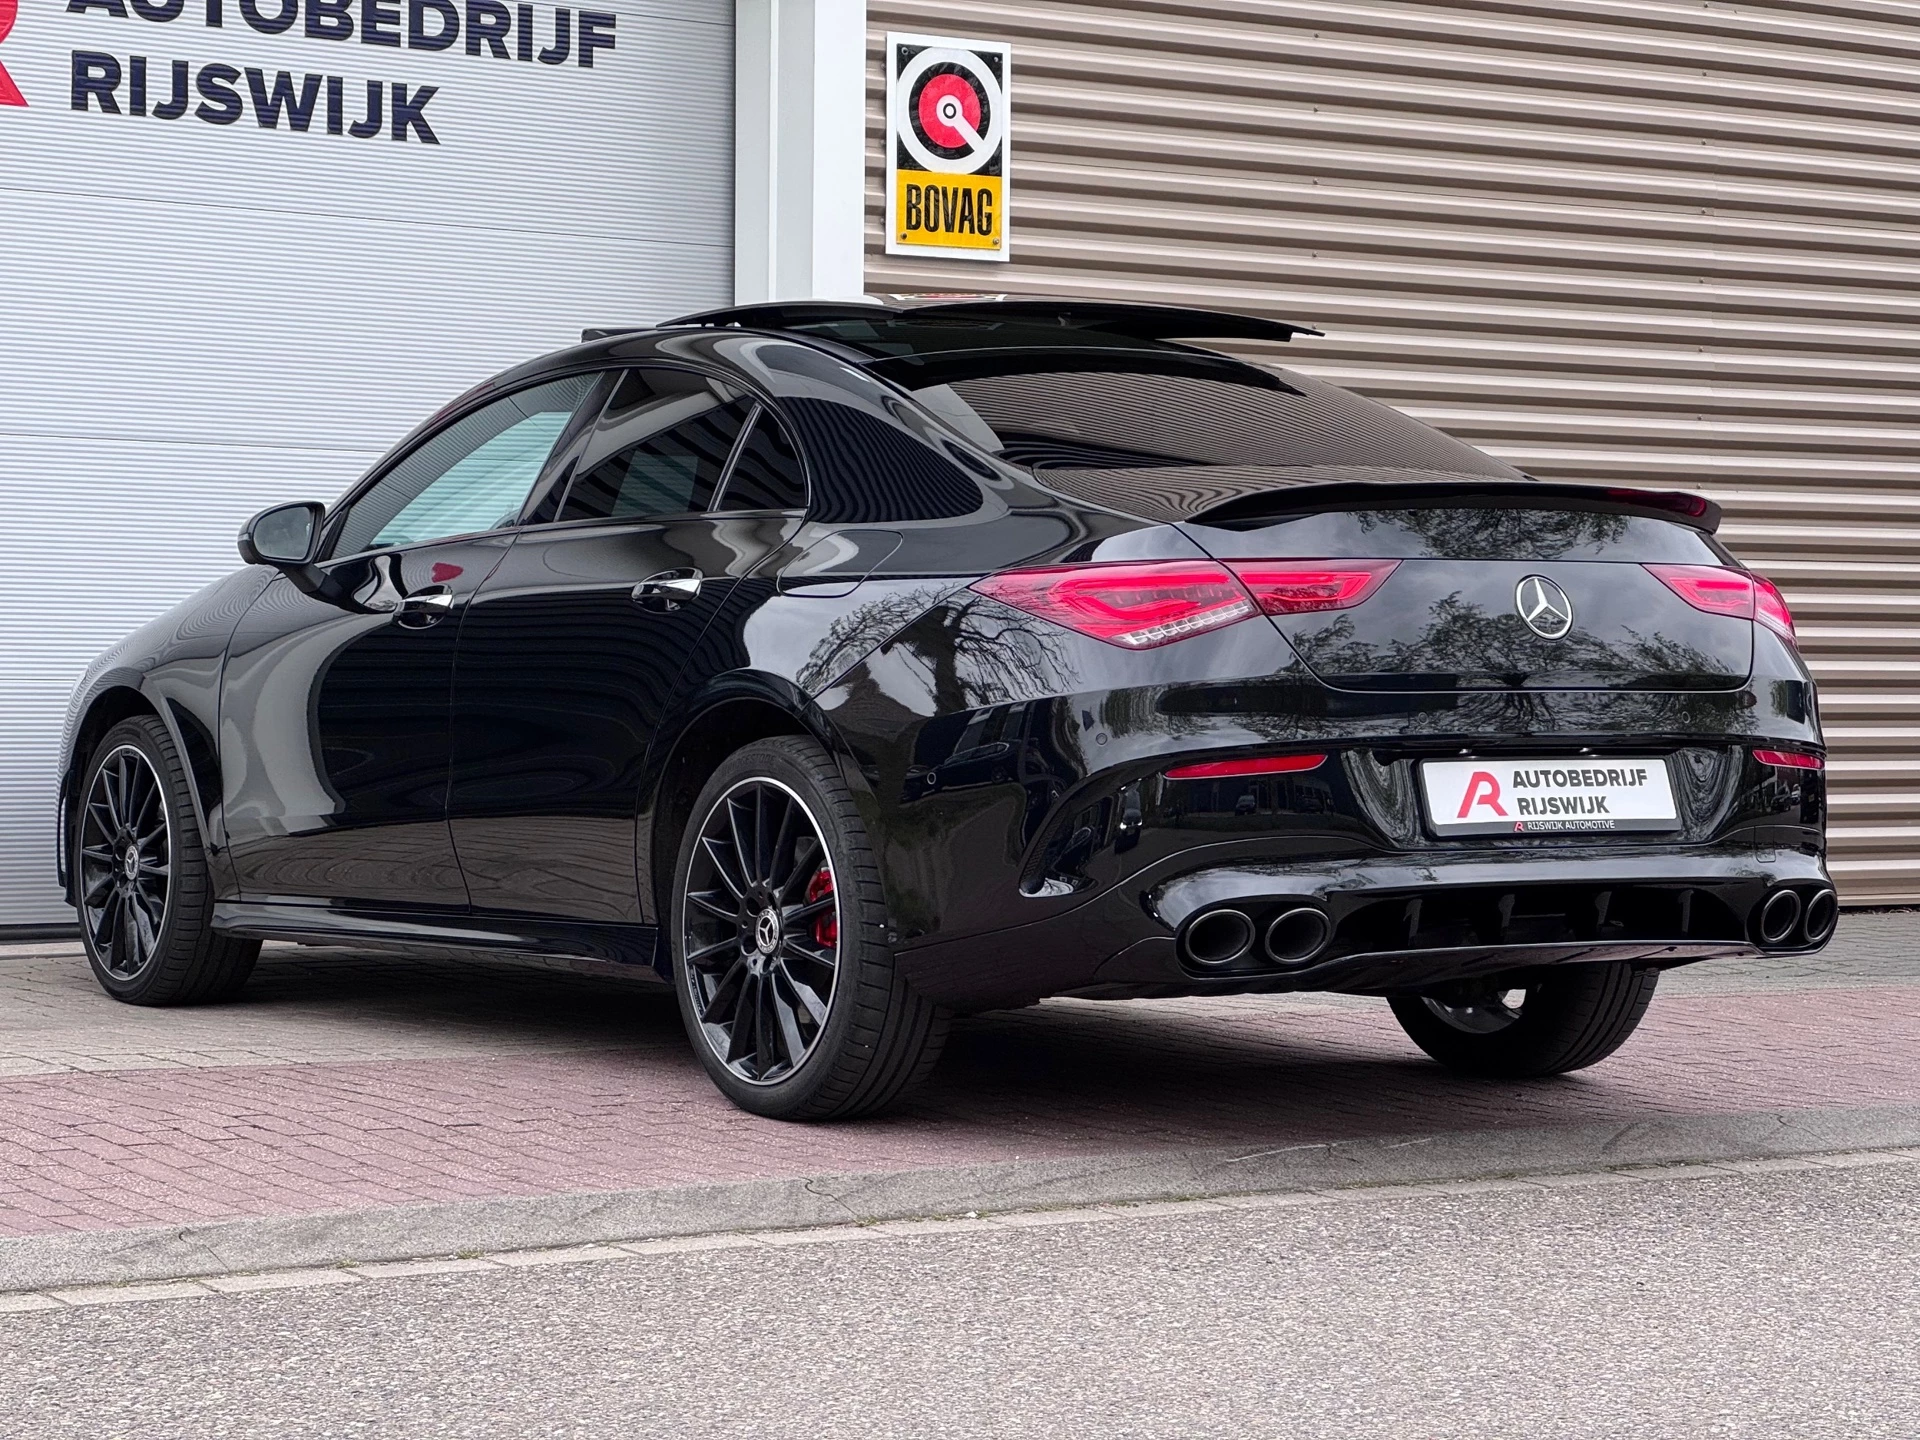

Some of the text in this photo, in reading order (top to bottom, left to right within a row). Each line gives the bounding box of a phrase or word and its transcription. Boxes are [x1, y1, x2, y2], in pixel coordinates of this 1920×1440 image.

[71, 50, 442, 145] RIJSWIJK
[906, 183, 993, 236] BOVAG
[1513, 768, 1648, 789] AUTOBEDRIJF
[1517, 796, 1610, 816] RIJSWIJK
[1527, 821, 1564, 831] RIJSWIJK
[1565, 820, 1616, 830] AUTOMOTIVE
